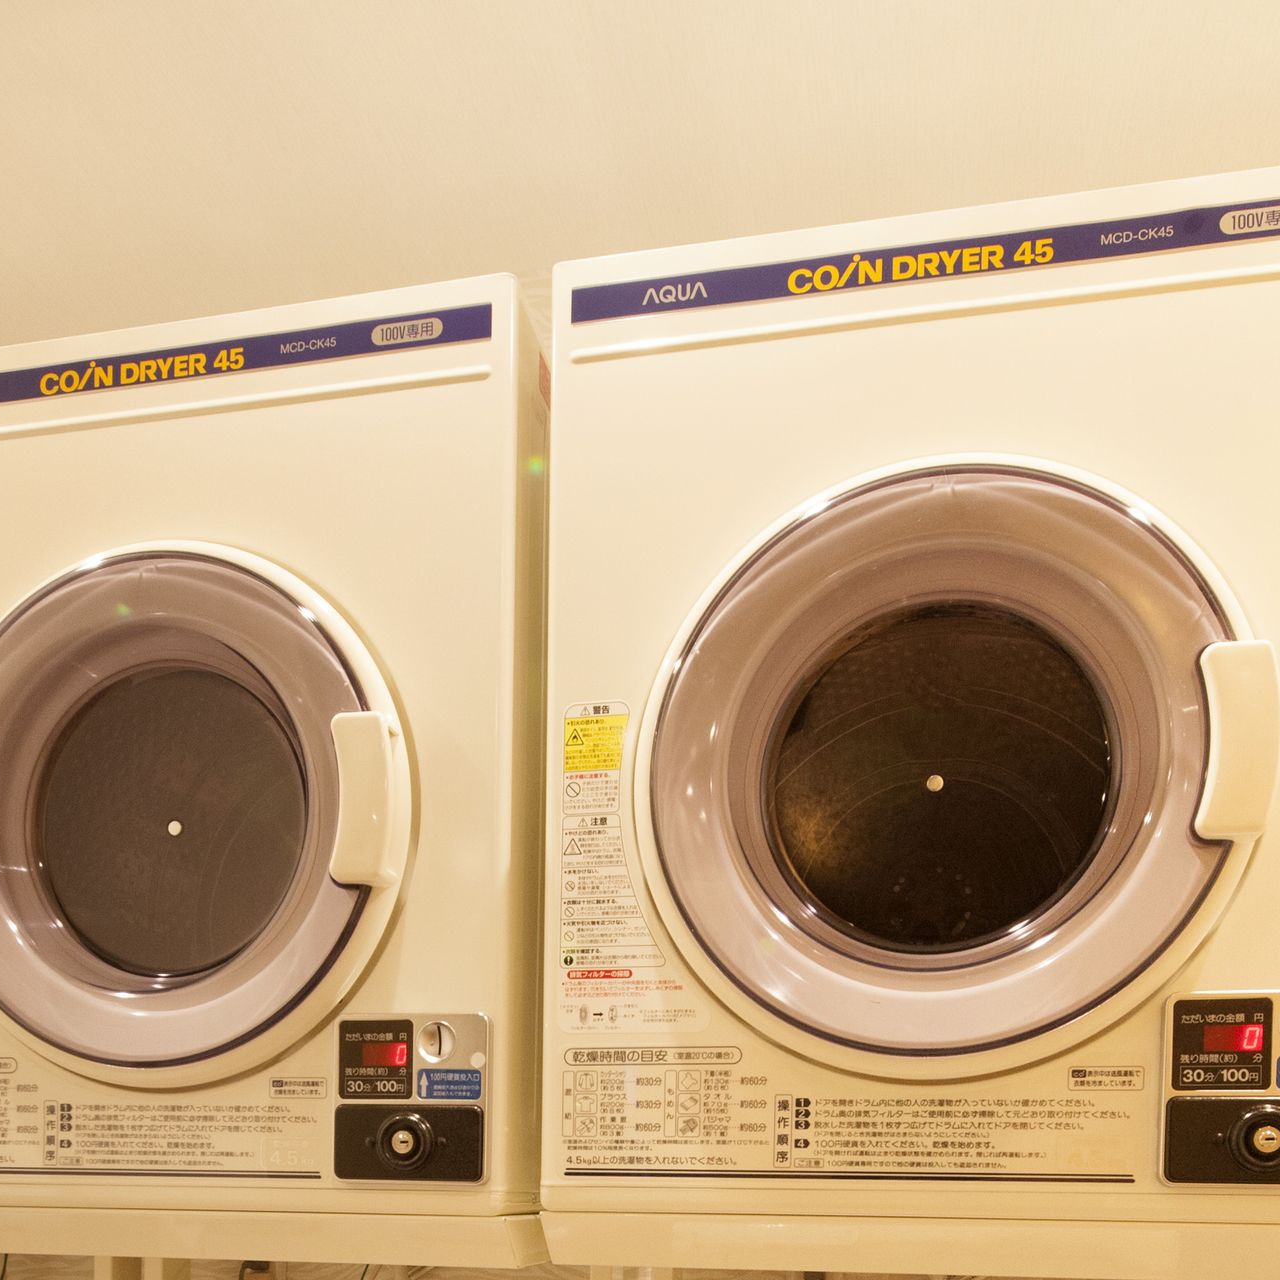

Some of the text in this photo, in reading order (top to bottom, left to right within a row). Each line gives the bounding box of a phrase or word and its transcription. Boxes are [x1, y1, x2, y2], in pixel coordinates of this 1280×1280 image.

[1100, 224, 1175, 247] MCD-CK45
[892, 245, 1005, 282] DRYER
[1013, 237, 1055, 266] 45
[642, 281, 708, 306] AQUA
[380, 321, 435, 343] 100V専用
[280, 336, 337, 355] MCD-CK45
[120, 354, 207, 386] DRYER
[213, 348, 245, 372] 45
[1254, 1013, 1264, 1022] 円
[1243, 1027, 1260, 1049] 0
[396, 1045, 407, 1064] 0
[573, 1050, 668, 1063] 乾燥時間の目安
